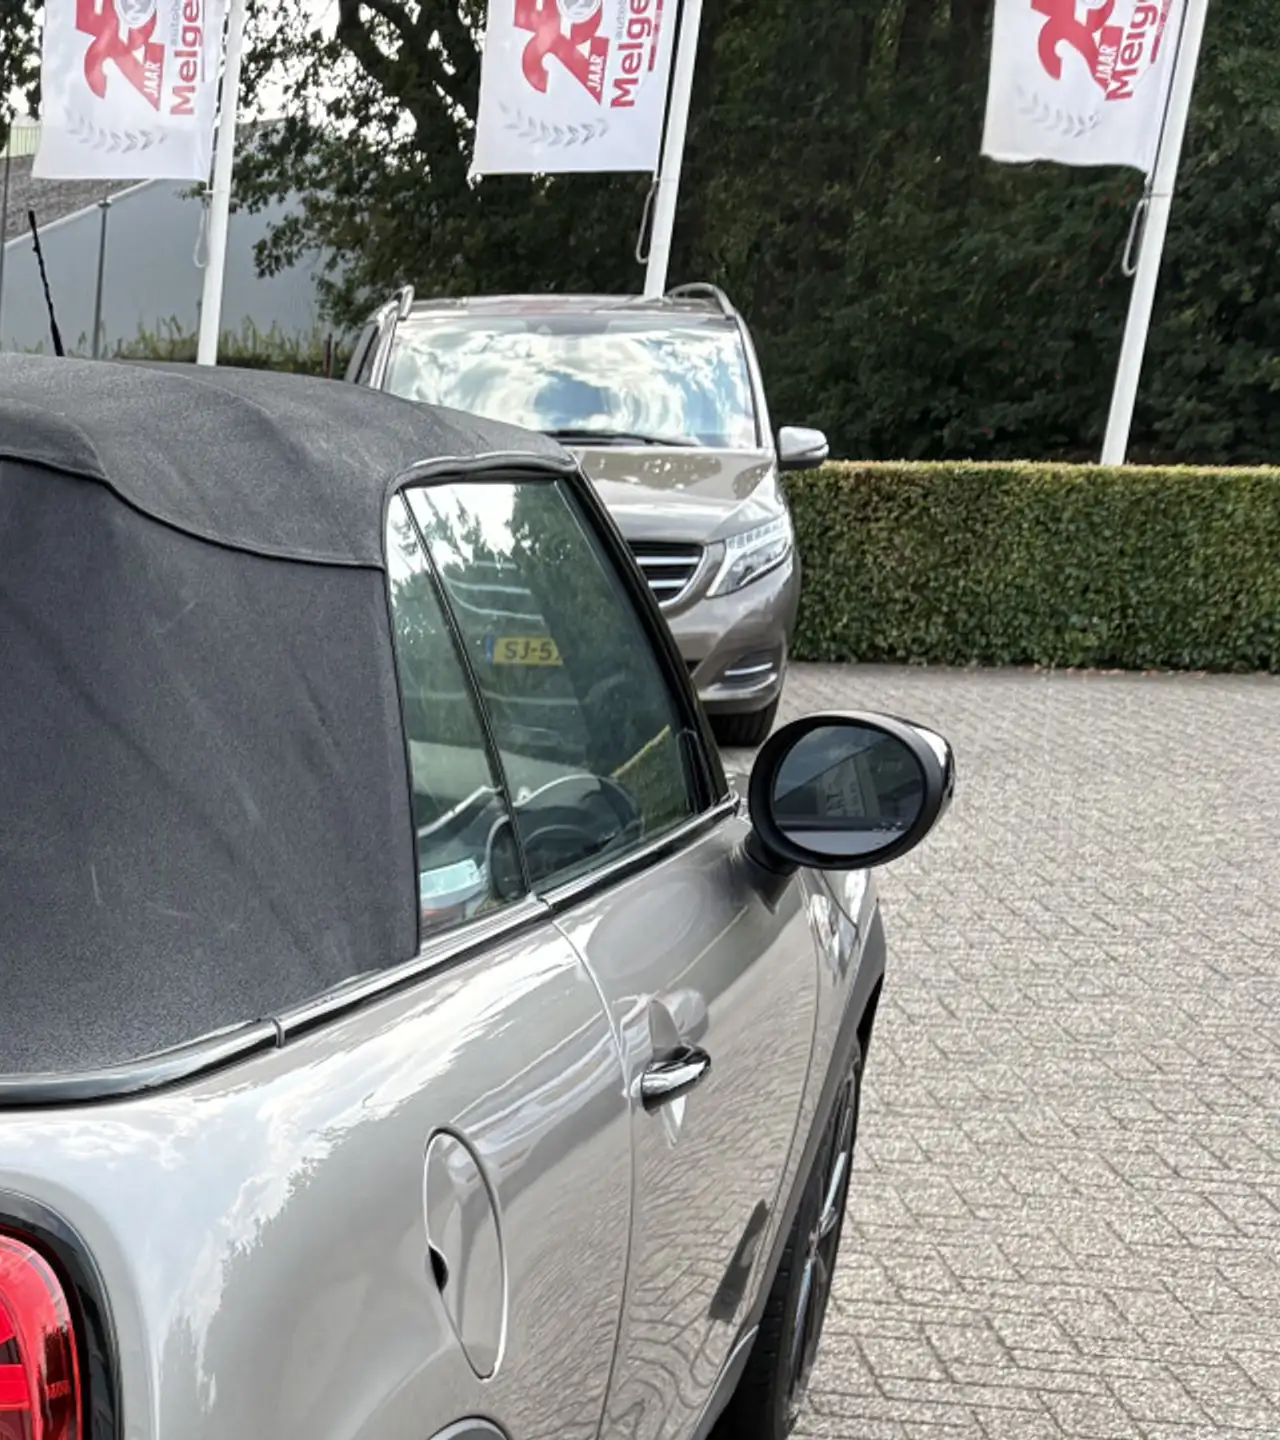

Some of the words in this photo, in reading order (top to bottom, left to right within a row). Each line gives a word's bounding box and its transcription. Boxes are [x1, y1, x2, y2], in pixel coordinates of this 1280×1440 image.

[1095, 44, 1118, 81] JAAR
[1104, 0, 1158, 100] Melg
[143, 61, 161, 97] JAAR
[587, 54, 605, 92] JAAR
[504, 640, 561, 661] SJ-5
